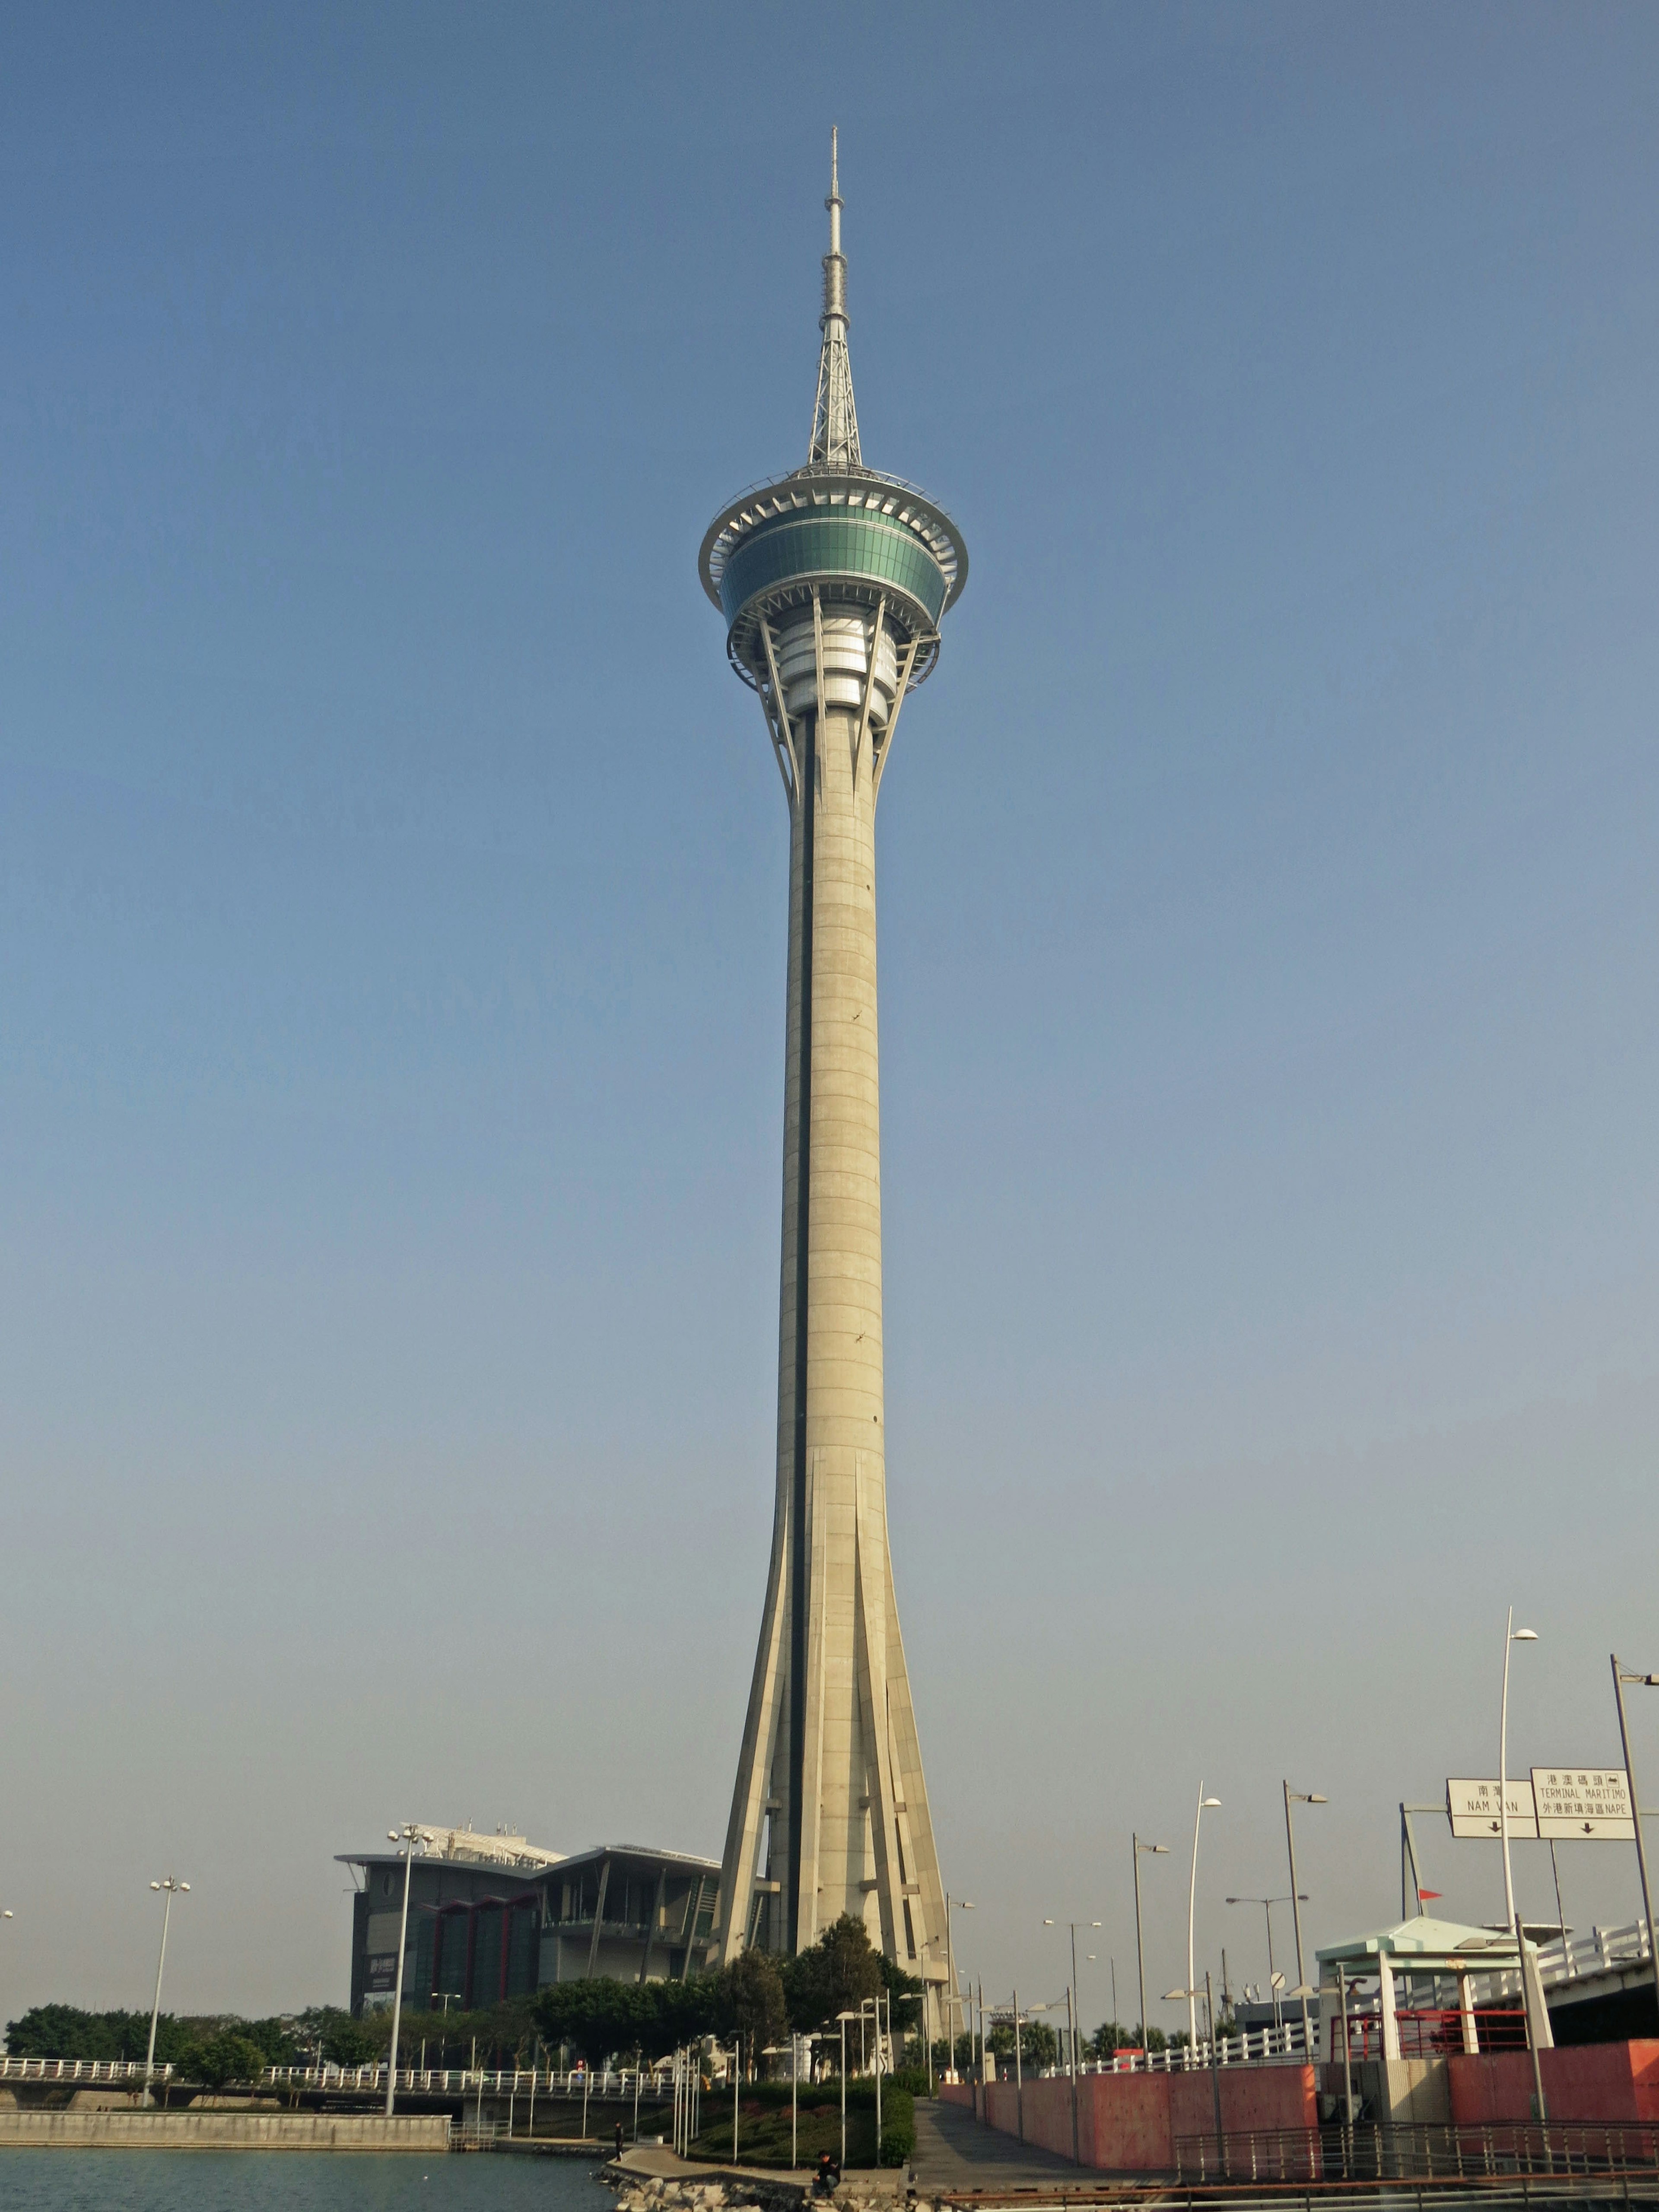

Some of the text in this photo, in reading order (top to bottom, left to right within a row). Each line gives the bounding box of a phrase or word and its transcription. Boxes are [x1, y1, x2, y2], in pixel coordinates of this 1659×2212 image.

[1548, 1774, 1603, 1786] 港澳碼頭
[1540, 1788, 1626, 1799] TERMINAL MARITIMO
[1468, 1800, 1489, 1811] NAM
[1605, 1804, 1627, 1814] NAPE
